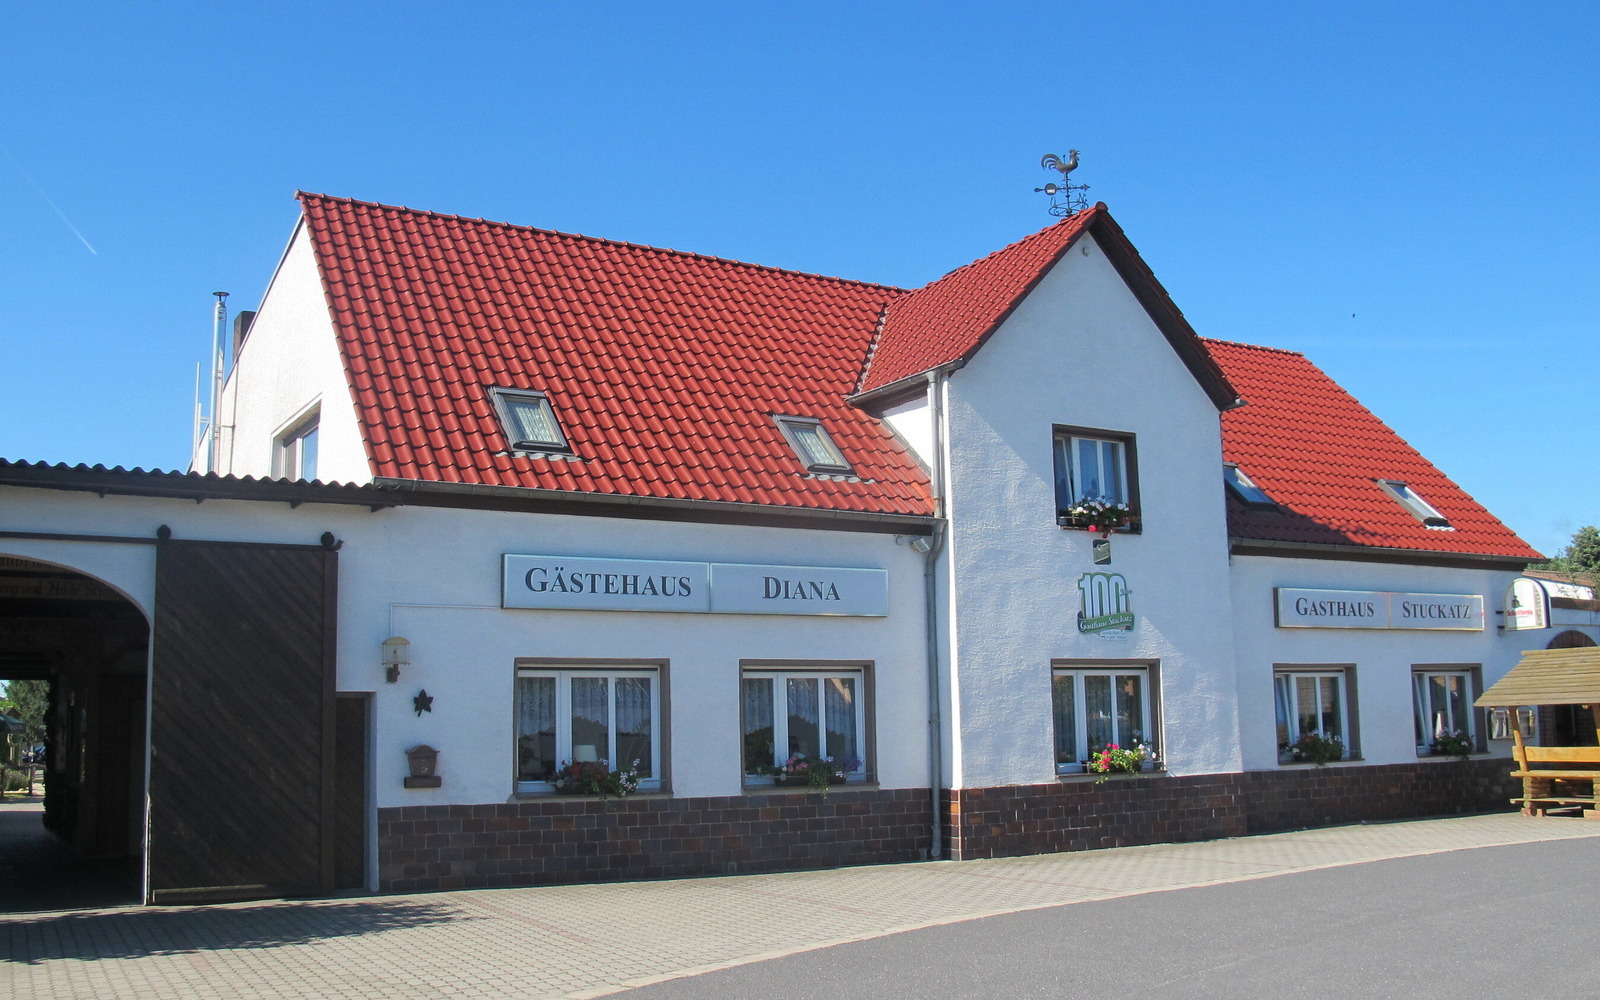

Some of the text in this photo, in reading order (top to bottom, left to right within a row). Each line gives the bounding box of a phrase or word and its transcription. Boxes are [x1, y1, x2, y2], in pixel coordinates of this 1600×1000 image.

[524, 566, 841, 601] GÄSTEHAUS DIANA
[1079, 573, 1127, 619] 100
[1295, 597, 1471, 620] GASTHAUS STUCKATZ
